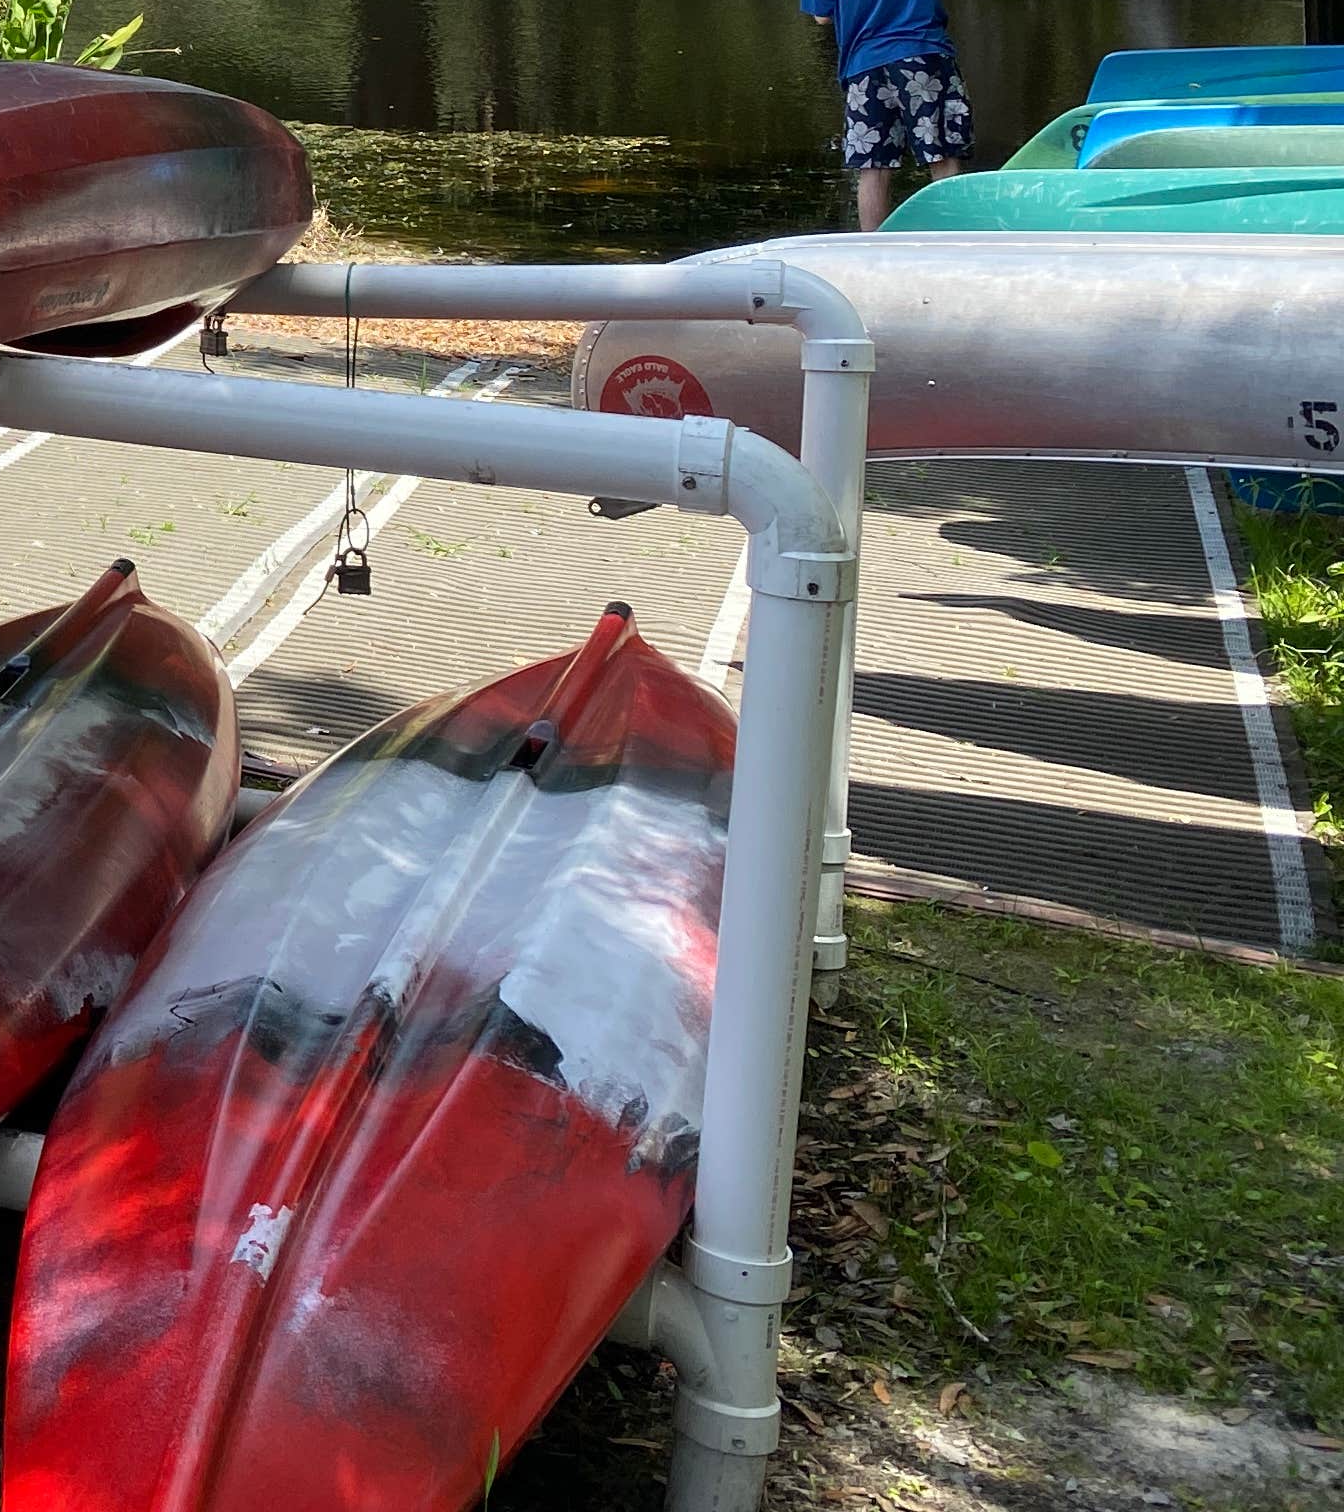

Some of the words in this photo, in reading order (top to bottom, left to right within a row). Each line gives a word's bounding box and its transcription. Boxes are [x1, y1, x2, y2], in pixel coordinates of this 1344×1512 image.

[615, 363, 643, 384] EAGLE
[643, 362, 669, 374] BALD
[1299, 401, 1340, 452] 5
